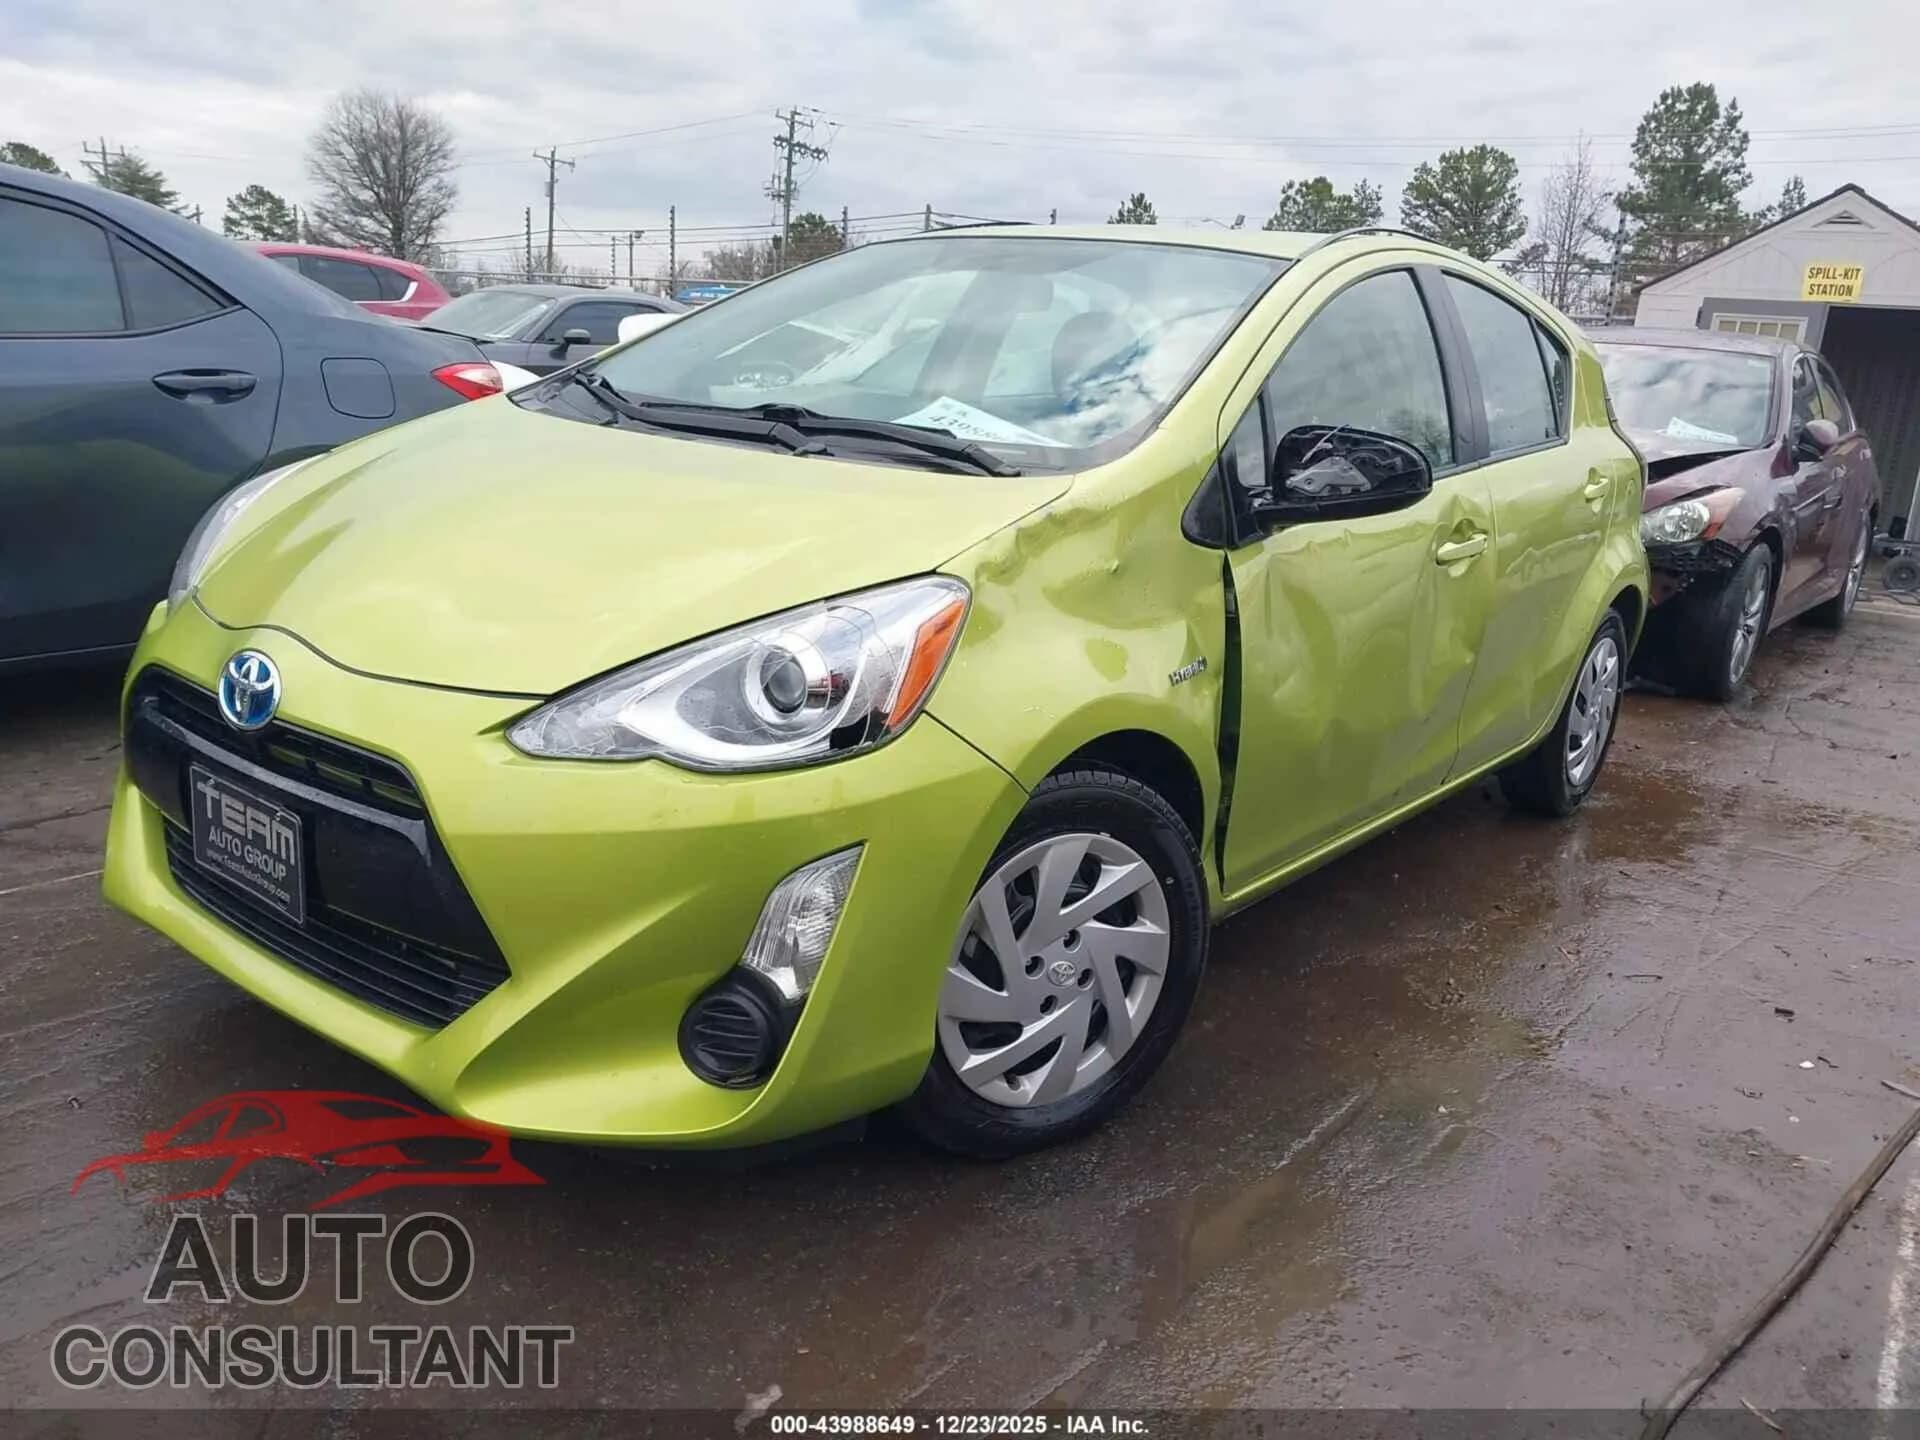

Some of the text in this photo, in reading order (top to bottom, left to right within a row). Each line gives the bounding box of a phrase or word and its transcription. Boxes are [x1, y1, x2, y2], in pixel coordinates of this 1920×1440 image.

[1807, 266, 1862, 281] SPILL-KIT
[1808, 283, 1854, 297] STATION
[208, 825, 287, 881] AUTO GROUP
